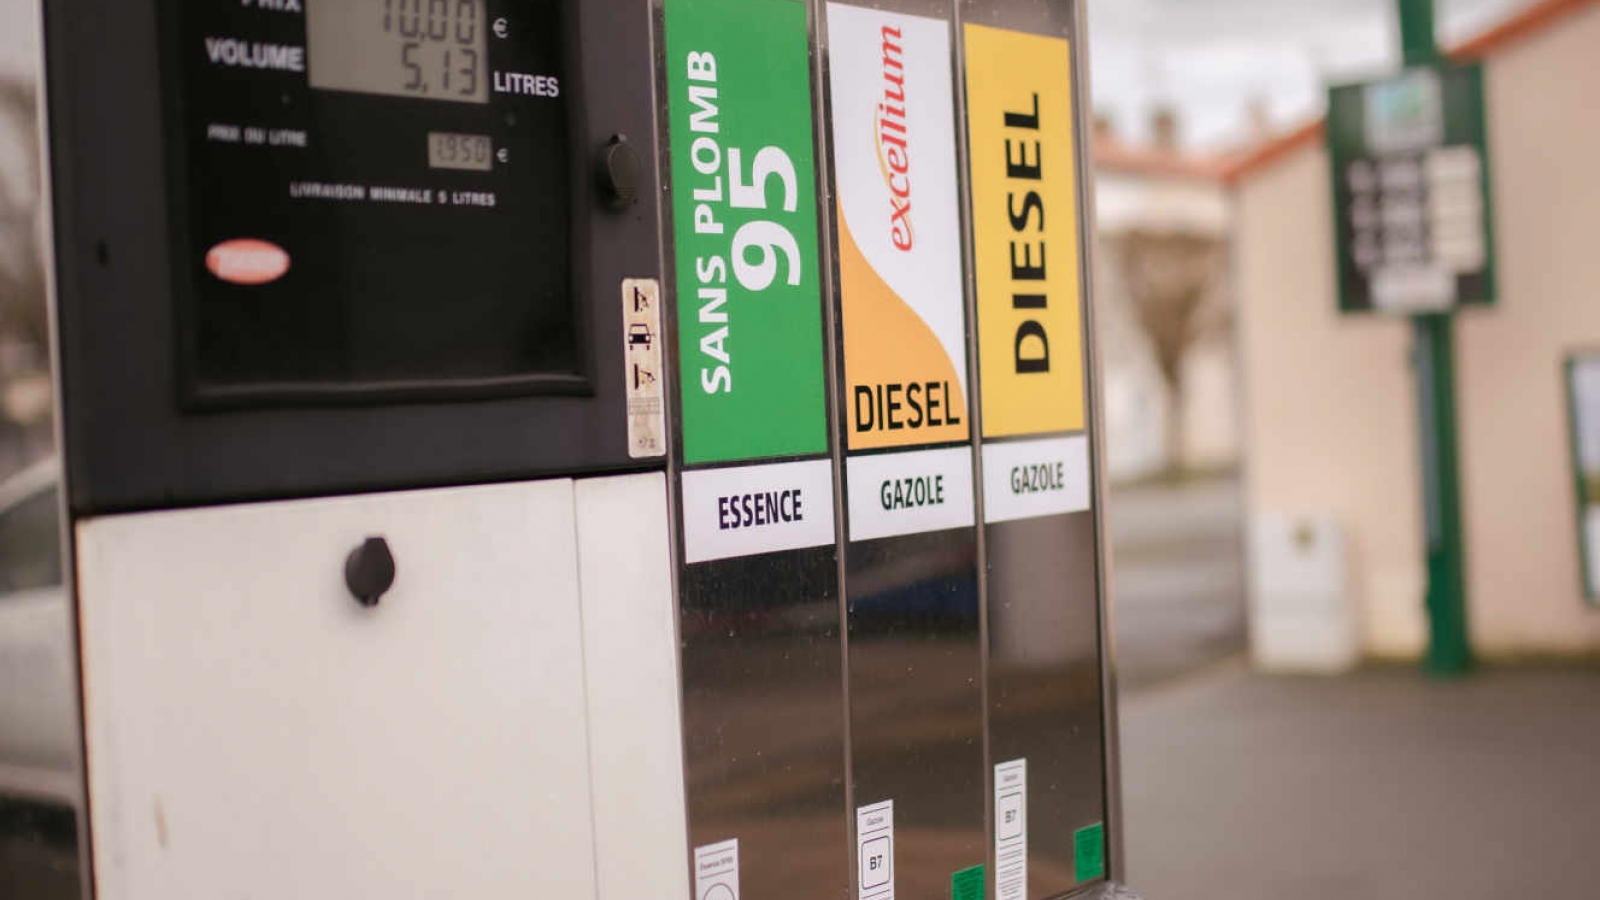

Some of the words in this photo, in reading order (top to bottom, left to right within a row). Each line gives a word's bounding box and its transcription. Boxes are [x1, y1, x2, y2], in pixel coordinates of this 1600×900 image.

[493, 18, 508, 38] €
[205, 37, 304, 71] VOLUME
[494, 71, 559, 97] LITRES
[687, 51, 724, 234] PLOMB
[879, 25, 914, 252] excellium
[290, 182, 365, 200] LIVRAISON
[370, 186, 432, 203] MINIMALE
[453, 192, 496, 206] LITRES
[727, 145, 801, 291] 95
[1004, 92, 1050, 374] DIESEL
[697, 255, 731, 394] SANS
[854, 381, 960, 432] DIESEL
[880, 475, 944, 510] GAZOLE
[1010, 462, 1064, 494] GAZOLE
[718, 489, 803, 529] ESSENCE
[869, 855, 883, 870] B7
